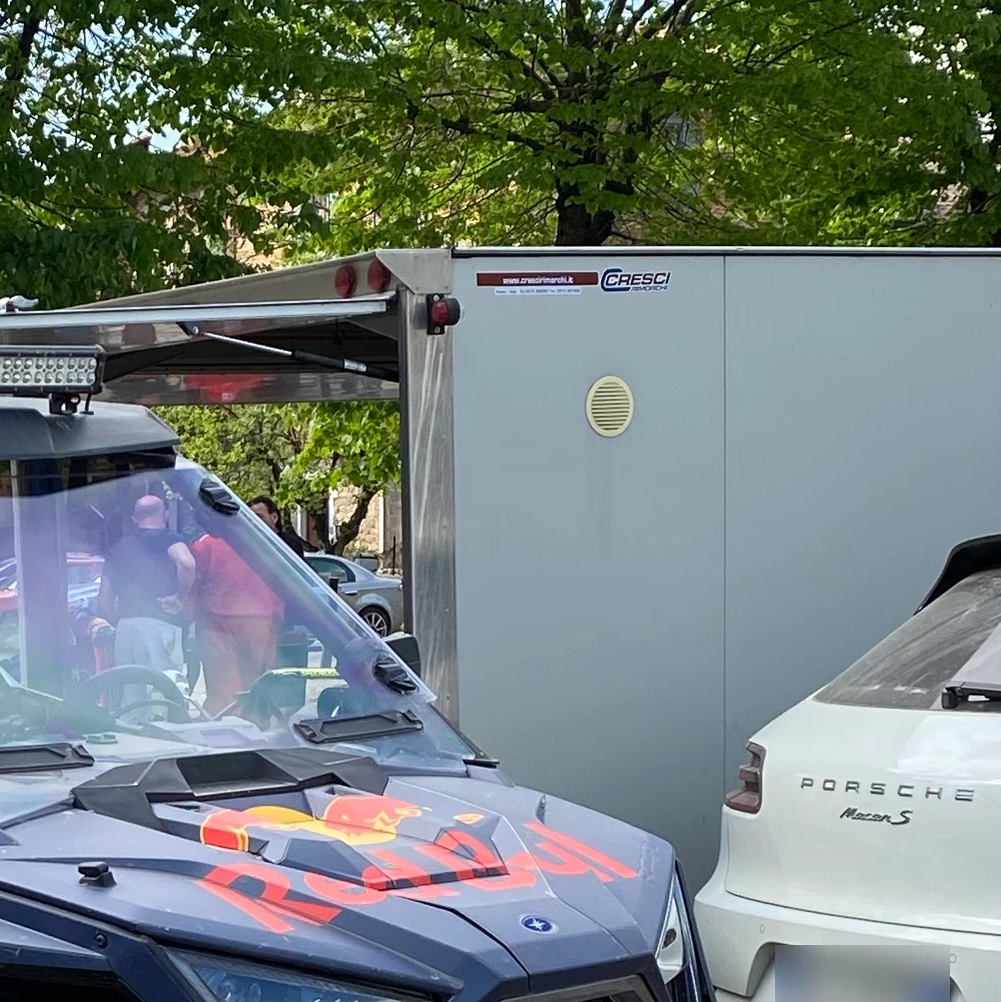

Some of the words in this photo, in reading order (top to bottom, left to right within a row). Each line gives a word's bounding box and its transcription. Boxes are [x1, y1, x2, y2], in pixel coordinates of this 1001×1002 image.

[602, 270, 671, 288] CRESCI
[801, 777, 975, 802] PORSCHE
[840, 806, 892, 823] Macan
[891, 809, 914, 826] S
